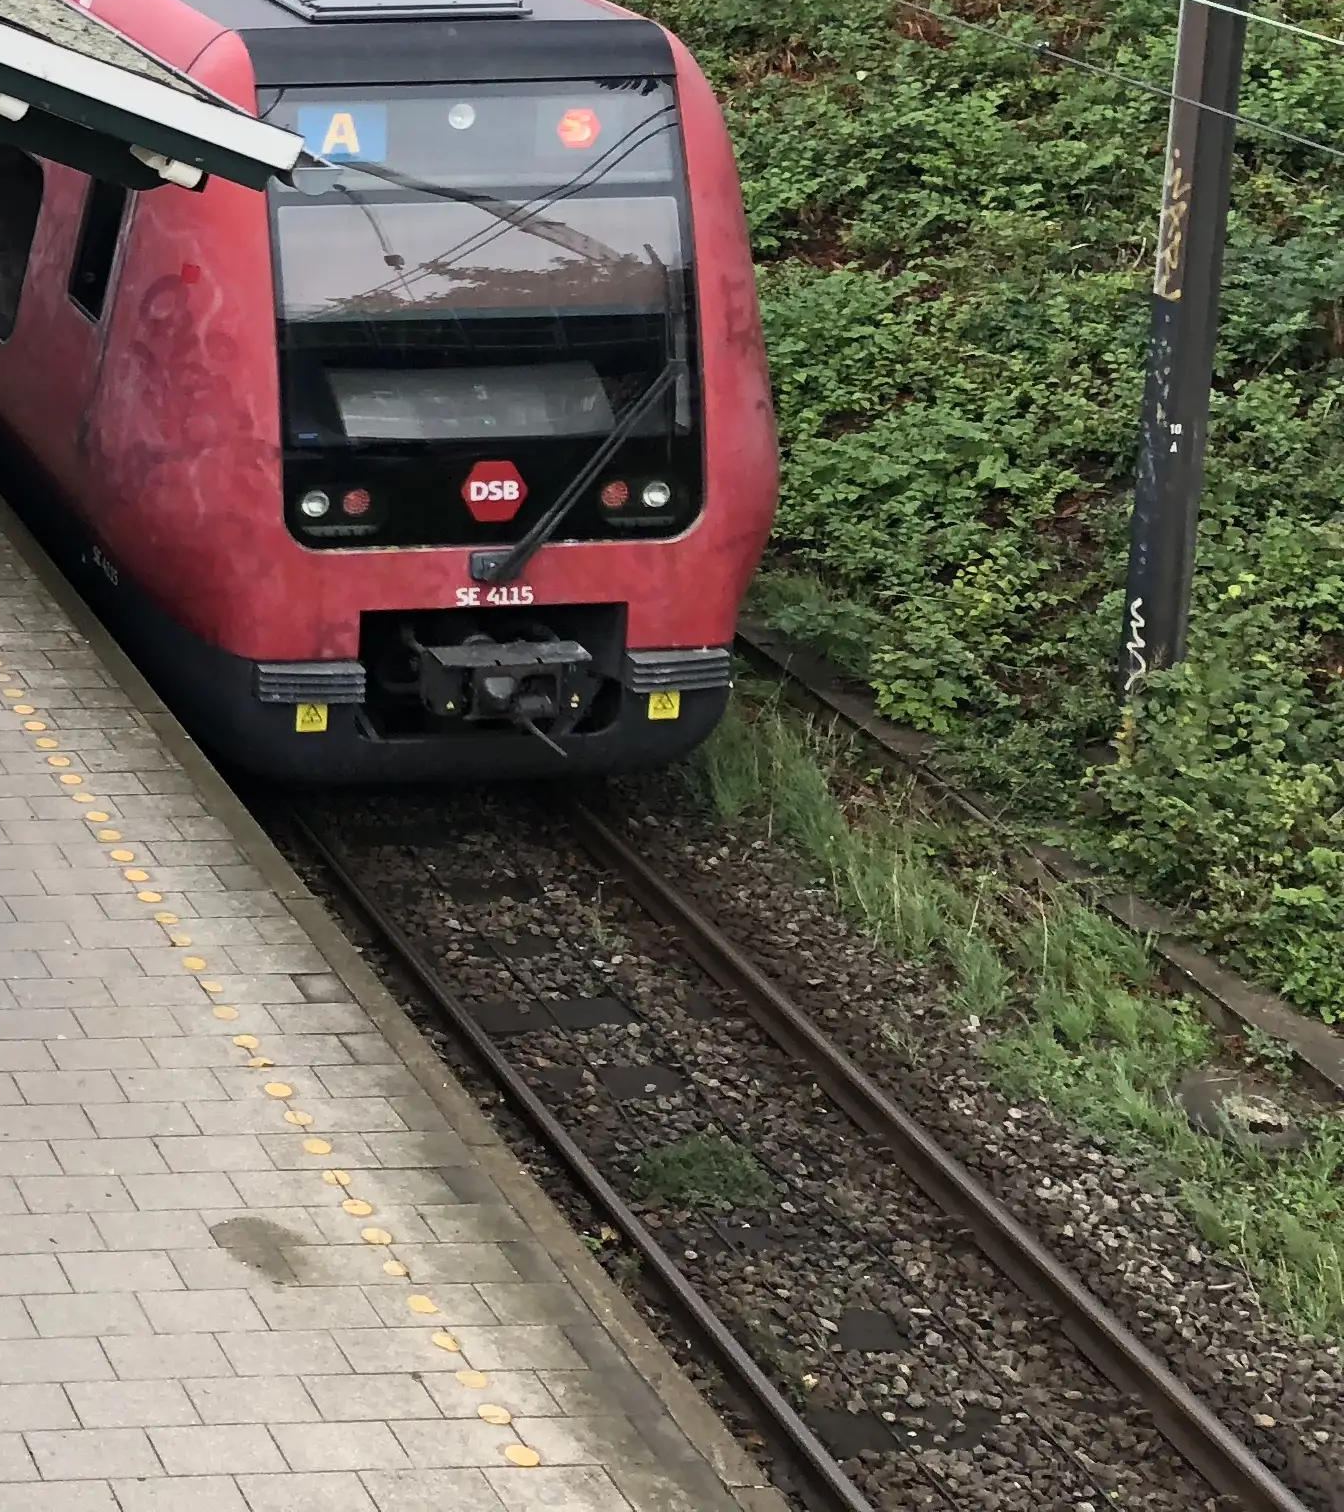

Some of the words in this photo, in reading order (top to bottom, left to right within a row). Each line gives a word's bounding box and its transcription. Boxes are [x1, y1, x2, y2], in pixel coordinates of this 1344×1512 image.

[321, 112, 361, 155] A
[560, 112, 593, 144] S
[1169, 423, 1183, 435] 10
[470, 480, 520, 502] DSB
[455, 586, 481, 607] SE
[486, 585, 535, 607] 4115
